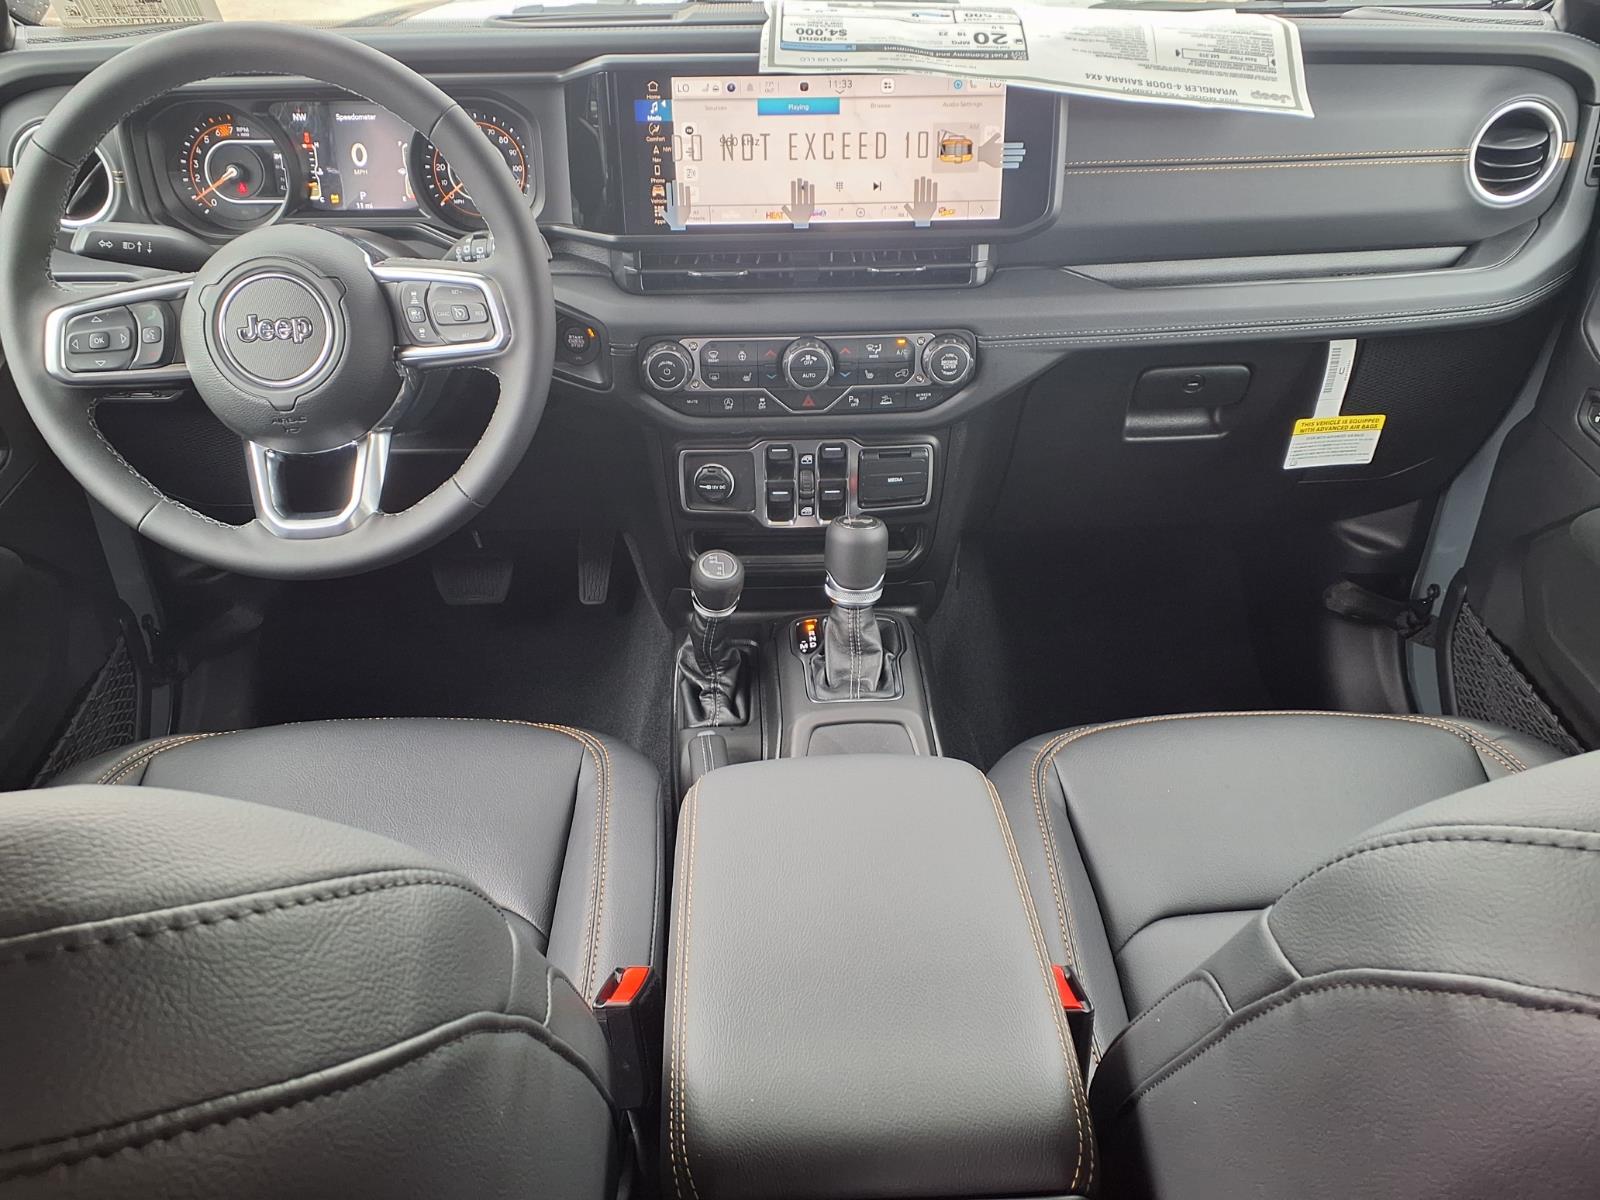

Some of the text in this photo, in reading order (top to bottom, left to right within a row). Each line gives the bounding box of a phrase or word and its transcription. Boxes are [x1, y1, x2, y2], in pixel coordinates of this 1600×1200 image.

[795, 27, 848, 36] $4,000
[973, 32, 1008, 45] 20
[883, 45, 935, 56] Environment
[953, 50, 992, 59] Economy
[992, 51, 1009, 59] Fuel
[1084, 72, 1103, 82] 4X4
[1104, 74, 1144, 87] SAHARA
[677, 83, 690, 93] LO
[828, 80, 853, 89] 11:33
[1145, 79, 1182, 91] 4-DOOR
[1185, 84, 1238, 96] WRANGLER
[1250, 90, 1293, 104] Jeep
[787, 103, 810, 111] Playing
[292, 113, 307, 121] NW
[335, 113, 377, 122] Speedometer
[228, 126, 234, 136] 7
[203, 136, 210, 144] 5
[498, 136, 510, 145] 80
[196, 146, 202, 155] 4
[671, 133, 703, 162] DO
[720, 132, 771, 162] NOT
[788, 131, 888, 161] EXCEED
[351, 142, 368, 167] 0
[508, 149, 518, 157] 90
[435, 163, 446, 172] 20
[512, 165, 523, 173] 100
[195, 174, 201, 183] 2
[440, 179, 448, 187] 10
[359, 191, 367, 199] P
[210, 199, 218, 207] 0
[765, 211, 784, 220] HEAT
[237, 314, 313, 344] Jeep
[93, 336, 105, 344] OK
[1315, 419, 1341, 427] VEHICLE
[1348, 417, 1380, 425] EQUIPPED
[809, 641, 817, 649] D
